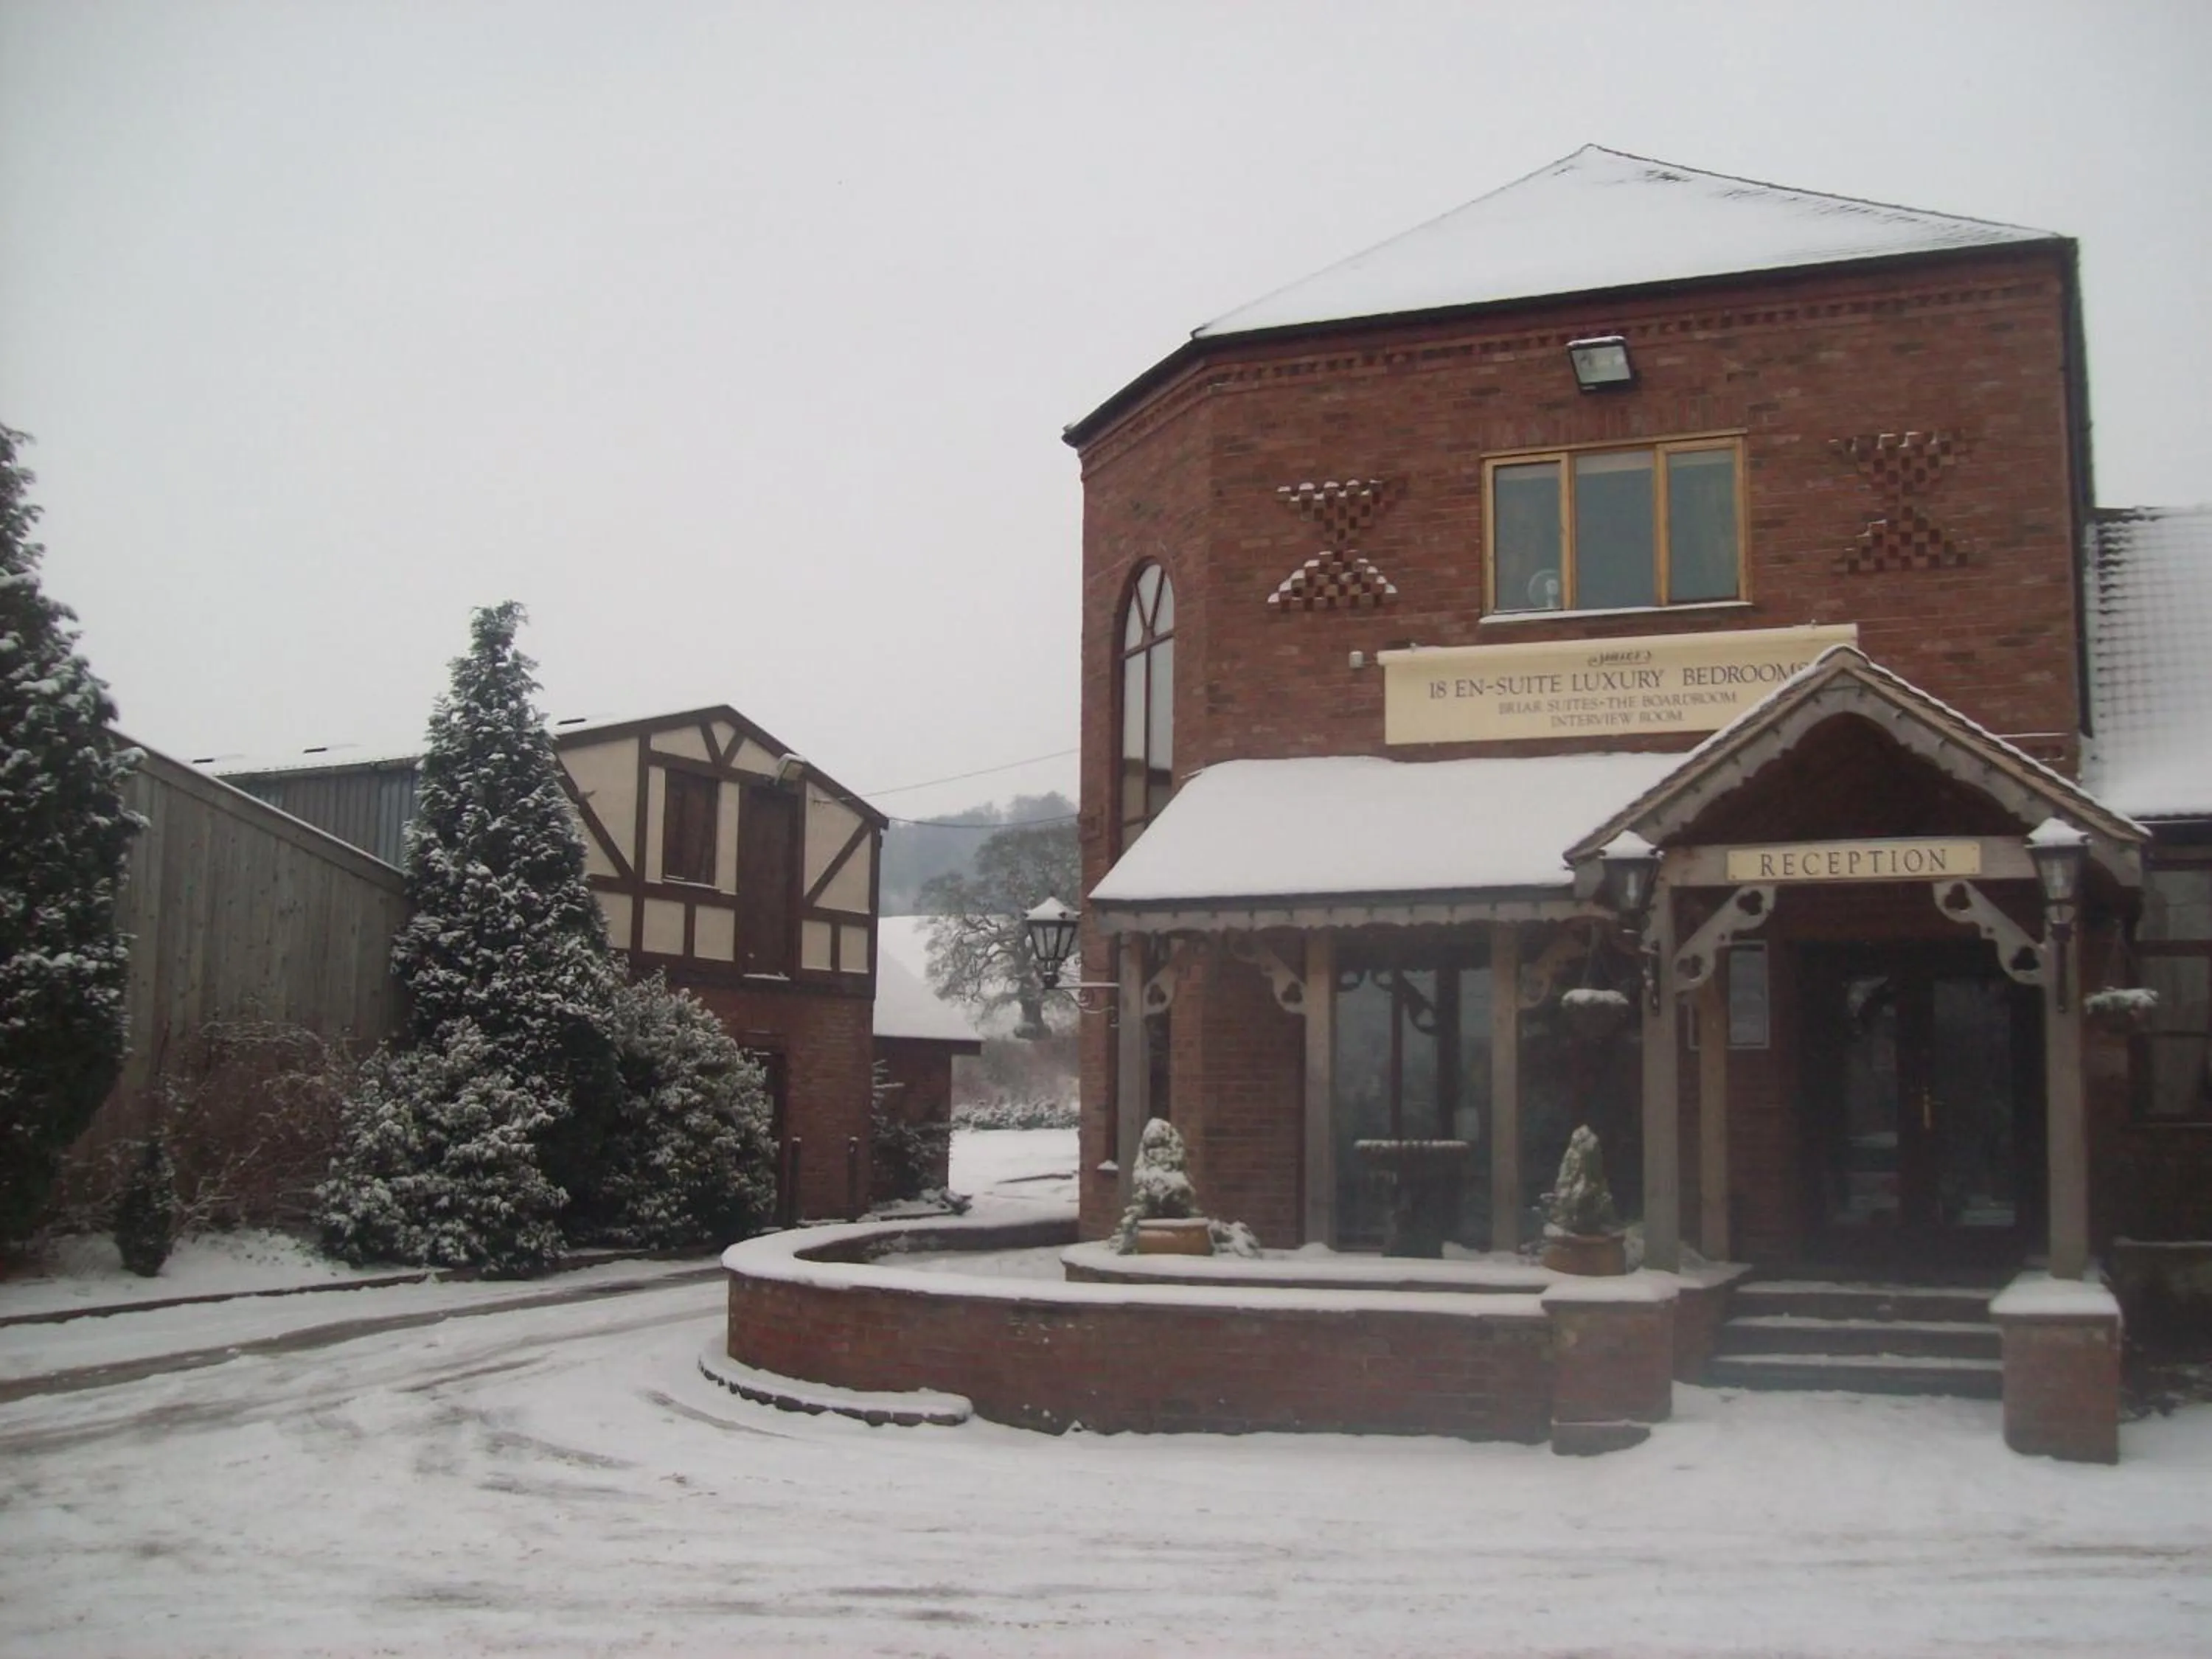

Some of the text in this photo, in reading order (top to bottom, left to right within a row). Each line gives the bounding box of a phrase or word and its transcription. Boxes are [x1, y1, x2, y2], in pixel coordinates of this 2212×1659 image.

[1429, 680, 1447, 700] 18
[1455, 674, 1563, 698] EN-SUITE
[1572, 669, 1664, 692] LUXURY
[1498, 700, 1543, 715] BRIAR
[1642, 691, 1737, 708] BOARDROOM
[1550, 709, 1684, 727] INTERVIEW ROOM
[1759, 849, 1948, 877] RECEPTION
